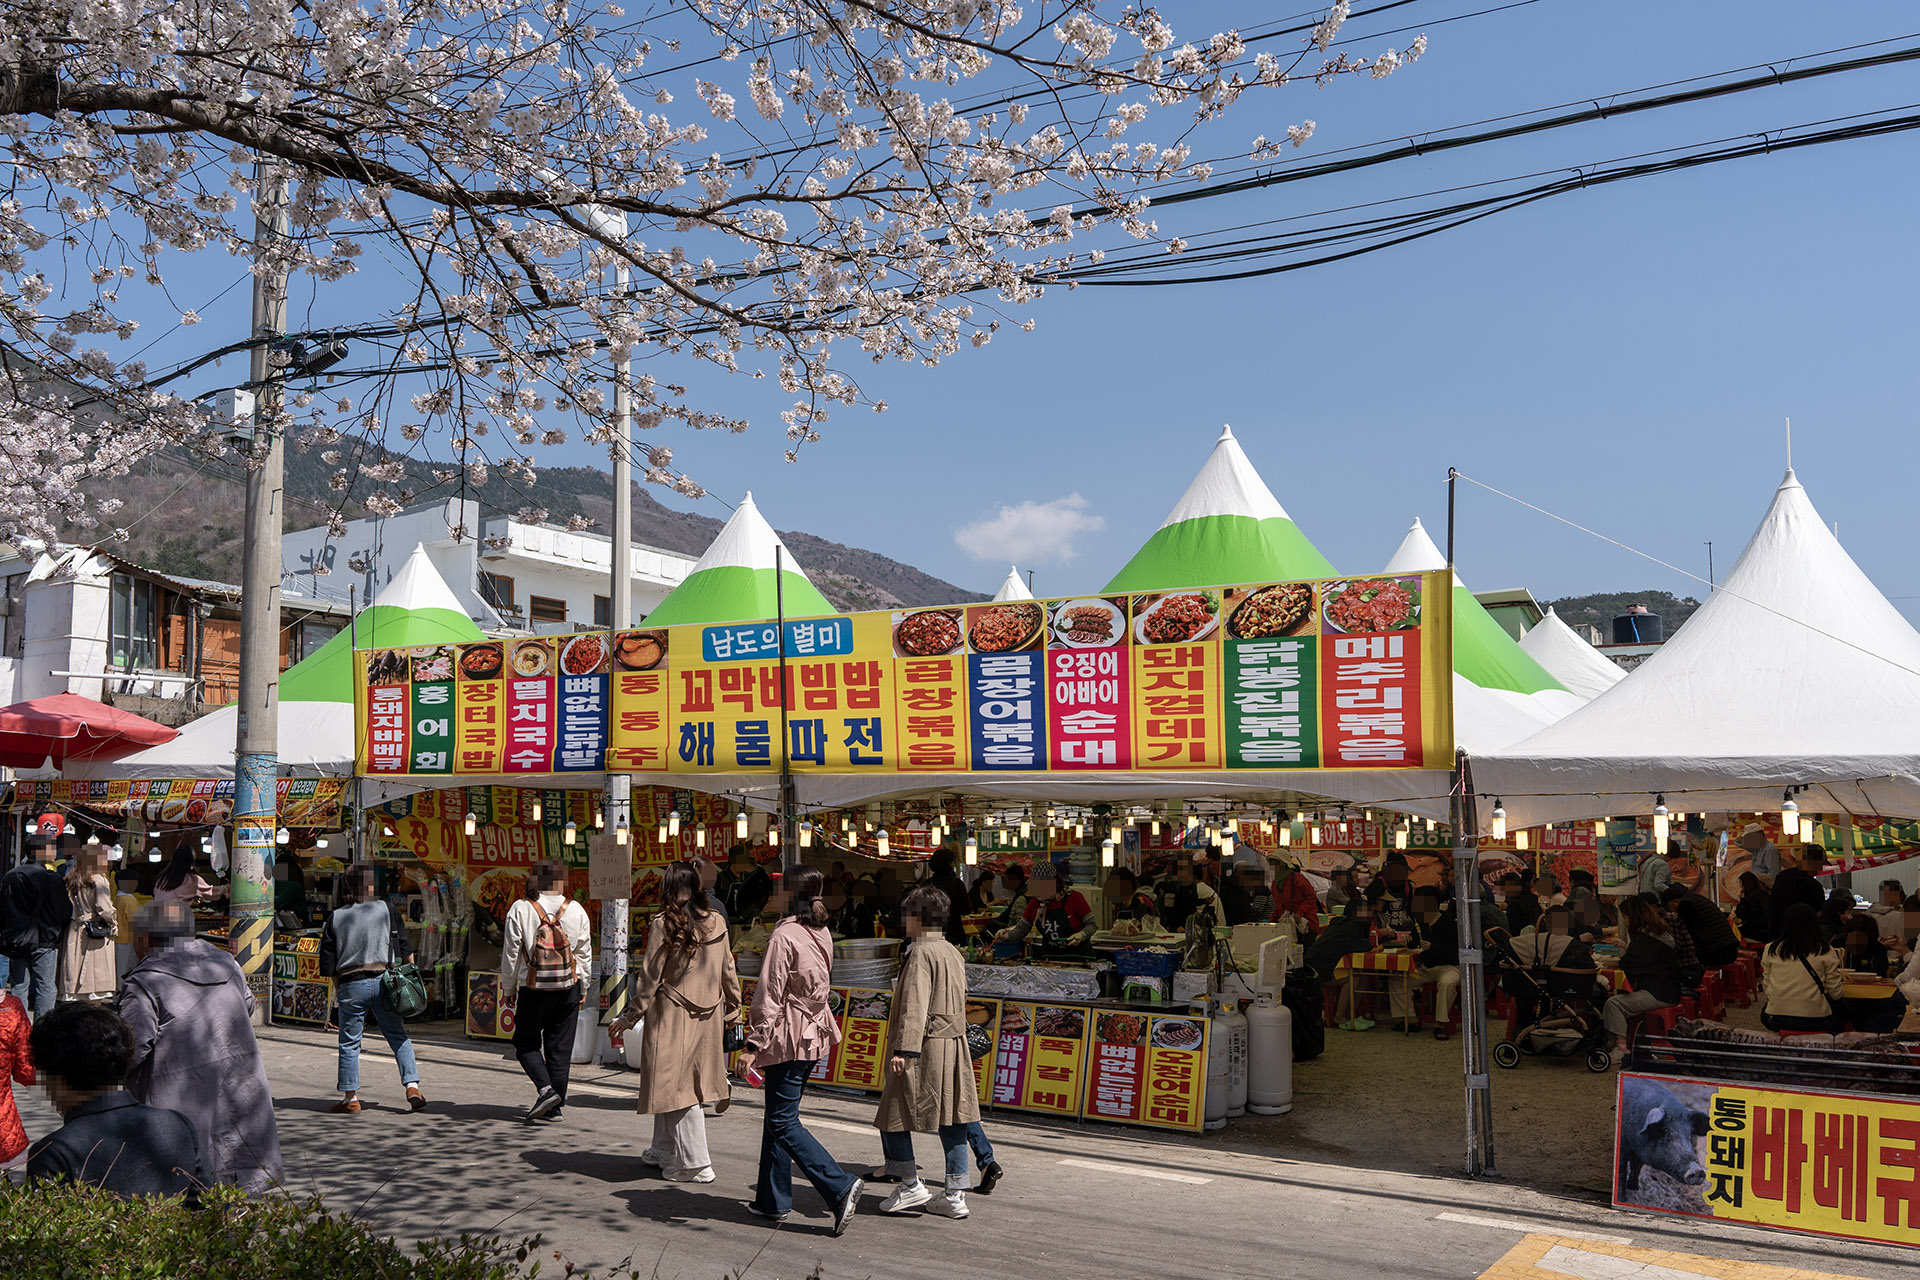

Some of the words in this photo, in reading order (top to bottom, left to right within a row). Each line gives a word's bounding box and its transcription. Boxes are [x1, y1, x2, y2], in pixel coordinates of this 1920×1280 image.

[710, 628, 780, 659] 남도의
[792, 621, 842, 652] 별미
[1055, 651, 1118, 678] 오징어
[371, 688, 405, 771] 통돼지바베큐
[415, 685, 449, 770] 홍어회
[461, 682, 499, 770] 장터국밥
[511, 680, 548, 769] 멸치국수
[561, 676, 604, 768] 뼈없는닭발
[615, 673, 662, 767] 동동주
[679, 664, 884, 714] 꼬막비빔밥
[902, 659, 957, 767] 곱창볶음
[976, 655, 1035, 766] 곰장어볶음
[1056, 678, 1119, 706] 아바이
[1142, 645, 1205, 764] 돼지껍데기
[1234, 640, 1305, 763] 닭똥집볶음
[1334, 635, 1407, 763] 메추리볶음
[678, 716, 884, 767] 해물파전
[1060, 709, 1118, 766] 순대
[36, 783, 51, 794] 소라
[151, 781, 170, 794] 식혜
[546, 791, 562, 826] 고래고기
[1044, 919, 1060, 941] 참
[1095, 1044, 1138, 1118] 뼈없는닭발
[1150, 1050, 1194, 1124] 오징어순대
[1708, 1097, 1747, 1208] 통돼지
[1751, 1105, 1920, 1229] 바베큐
